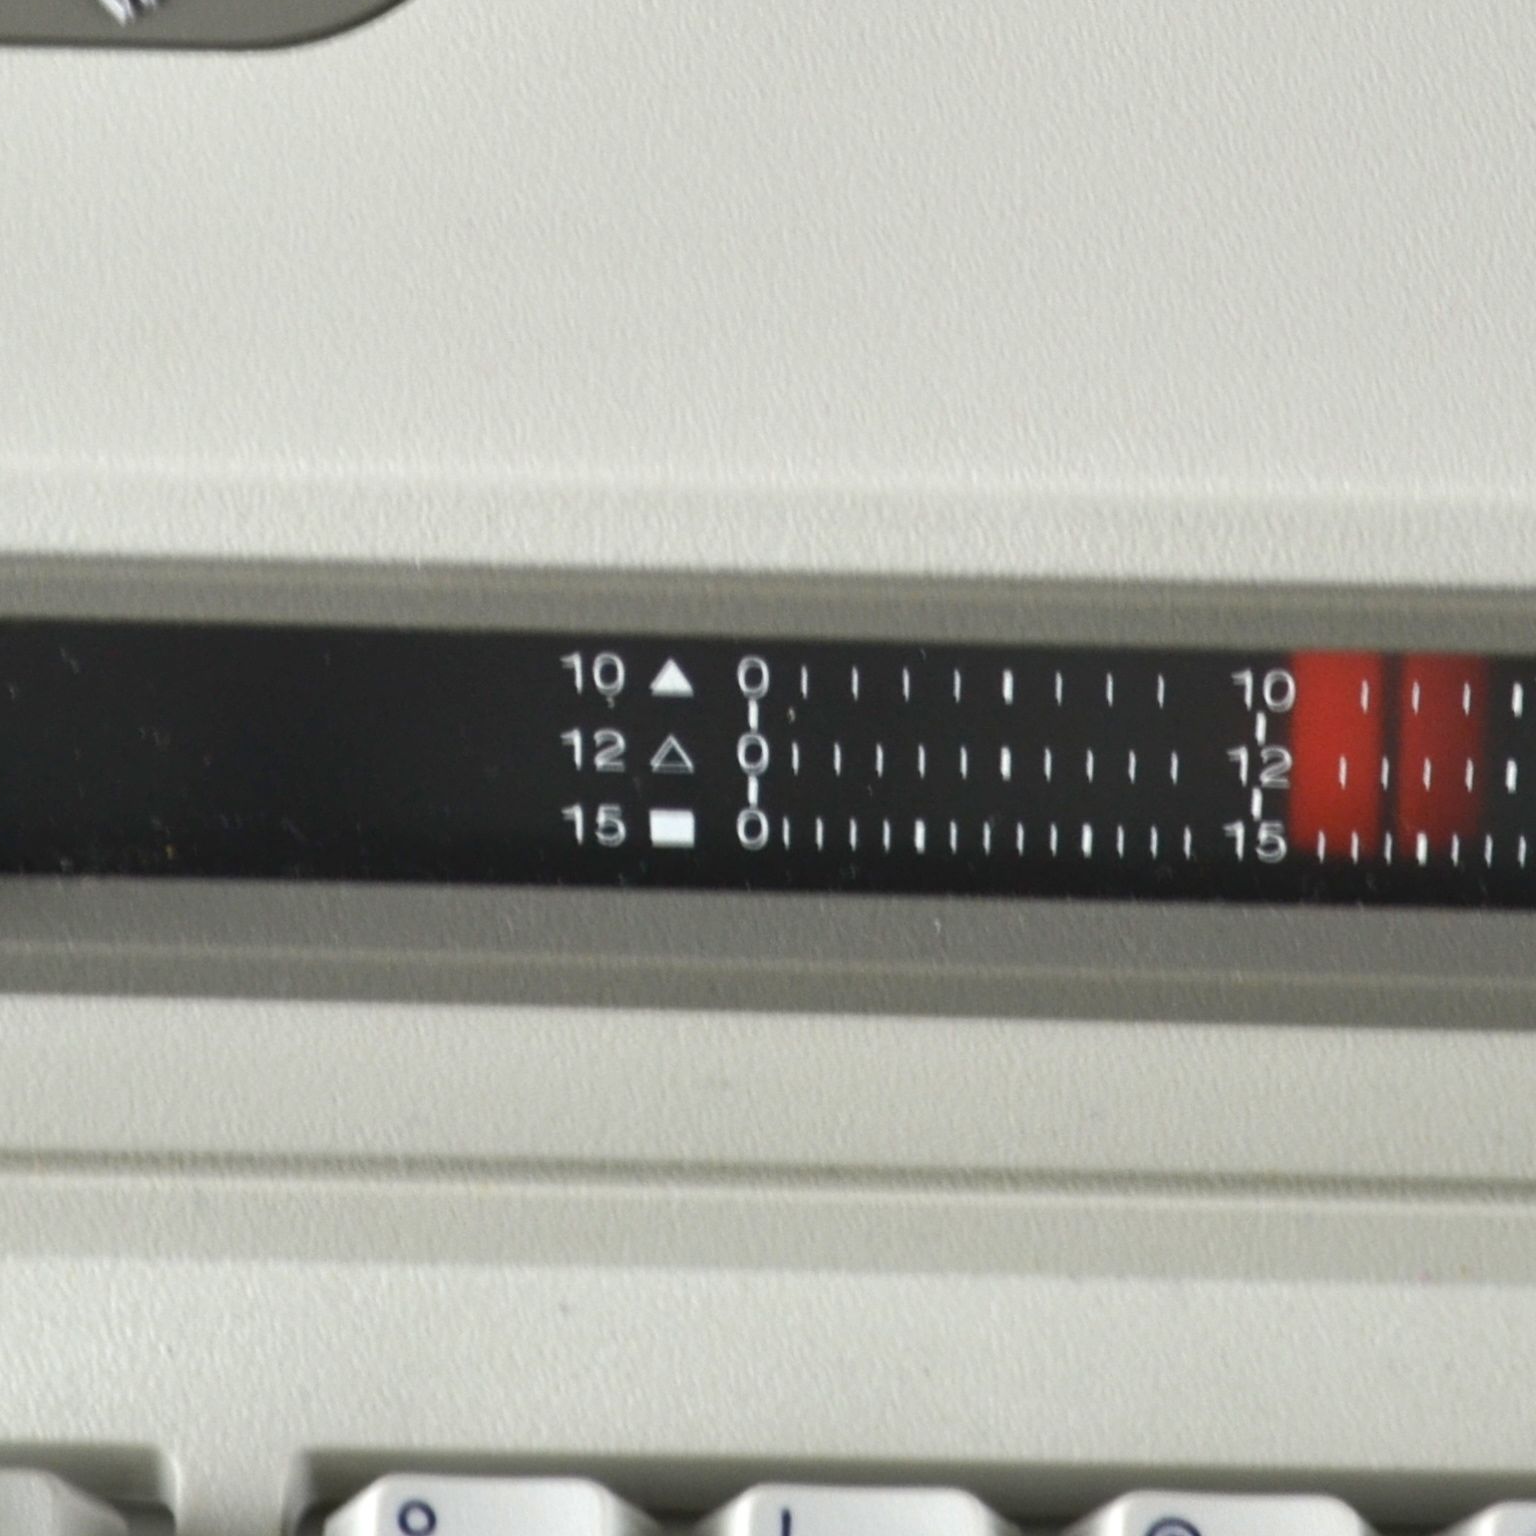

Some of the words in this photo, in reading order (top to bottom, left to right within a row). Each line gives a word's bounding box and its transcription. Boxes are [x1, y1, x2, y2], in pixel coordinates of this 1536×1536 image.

[560, 652, 626, 697] 10
[736, 654, 770, 700] 0
[1230, 668, 1297, 713] 10
[560, 727, 627, 773] 12
[736, 732, 770, 776] 0
[1226, 744, 1294, 789] 12
[561, 803, 627, 848] 15
[736, 808, 770, 852] 0
[1222, 820, 1288, 864] 15
